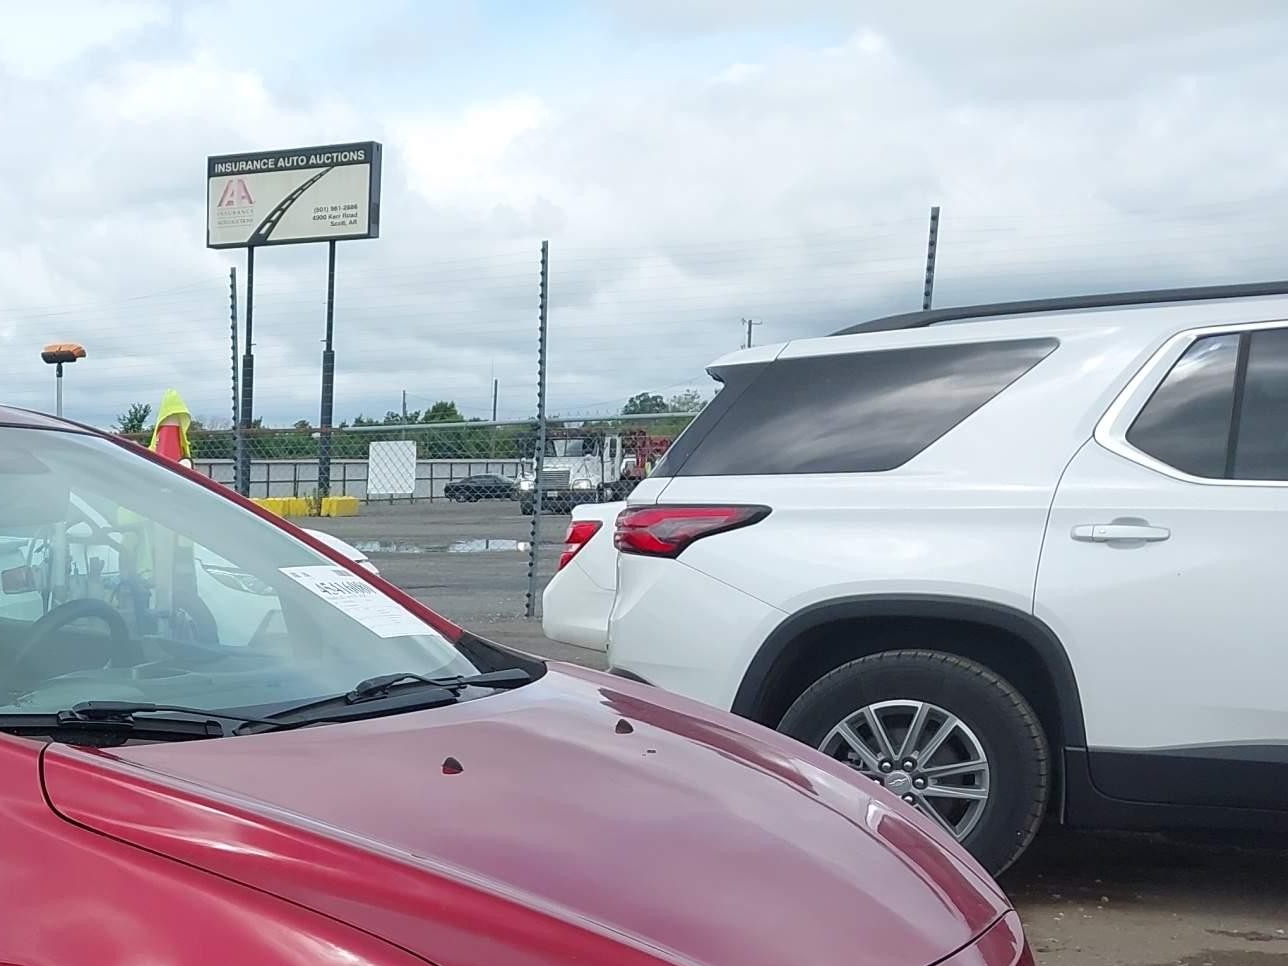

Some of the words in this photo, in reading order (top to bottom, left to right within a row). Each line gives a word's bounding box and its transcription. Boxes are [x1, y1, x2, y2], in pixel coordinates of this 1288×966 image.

[215, 158, 275, 173] INSURANCE
[277, 155, 307, 168] AUTO
[308, 150, 366, 165] AUCTIONS
